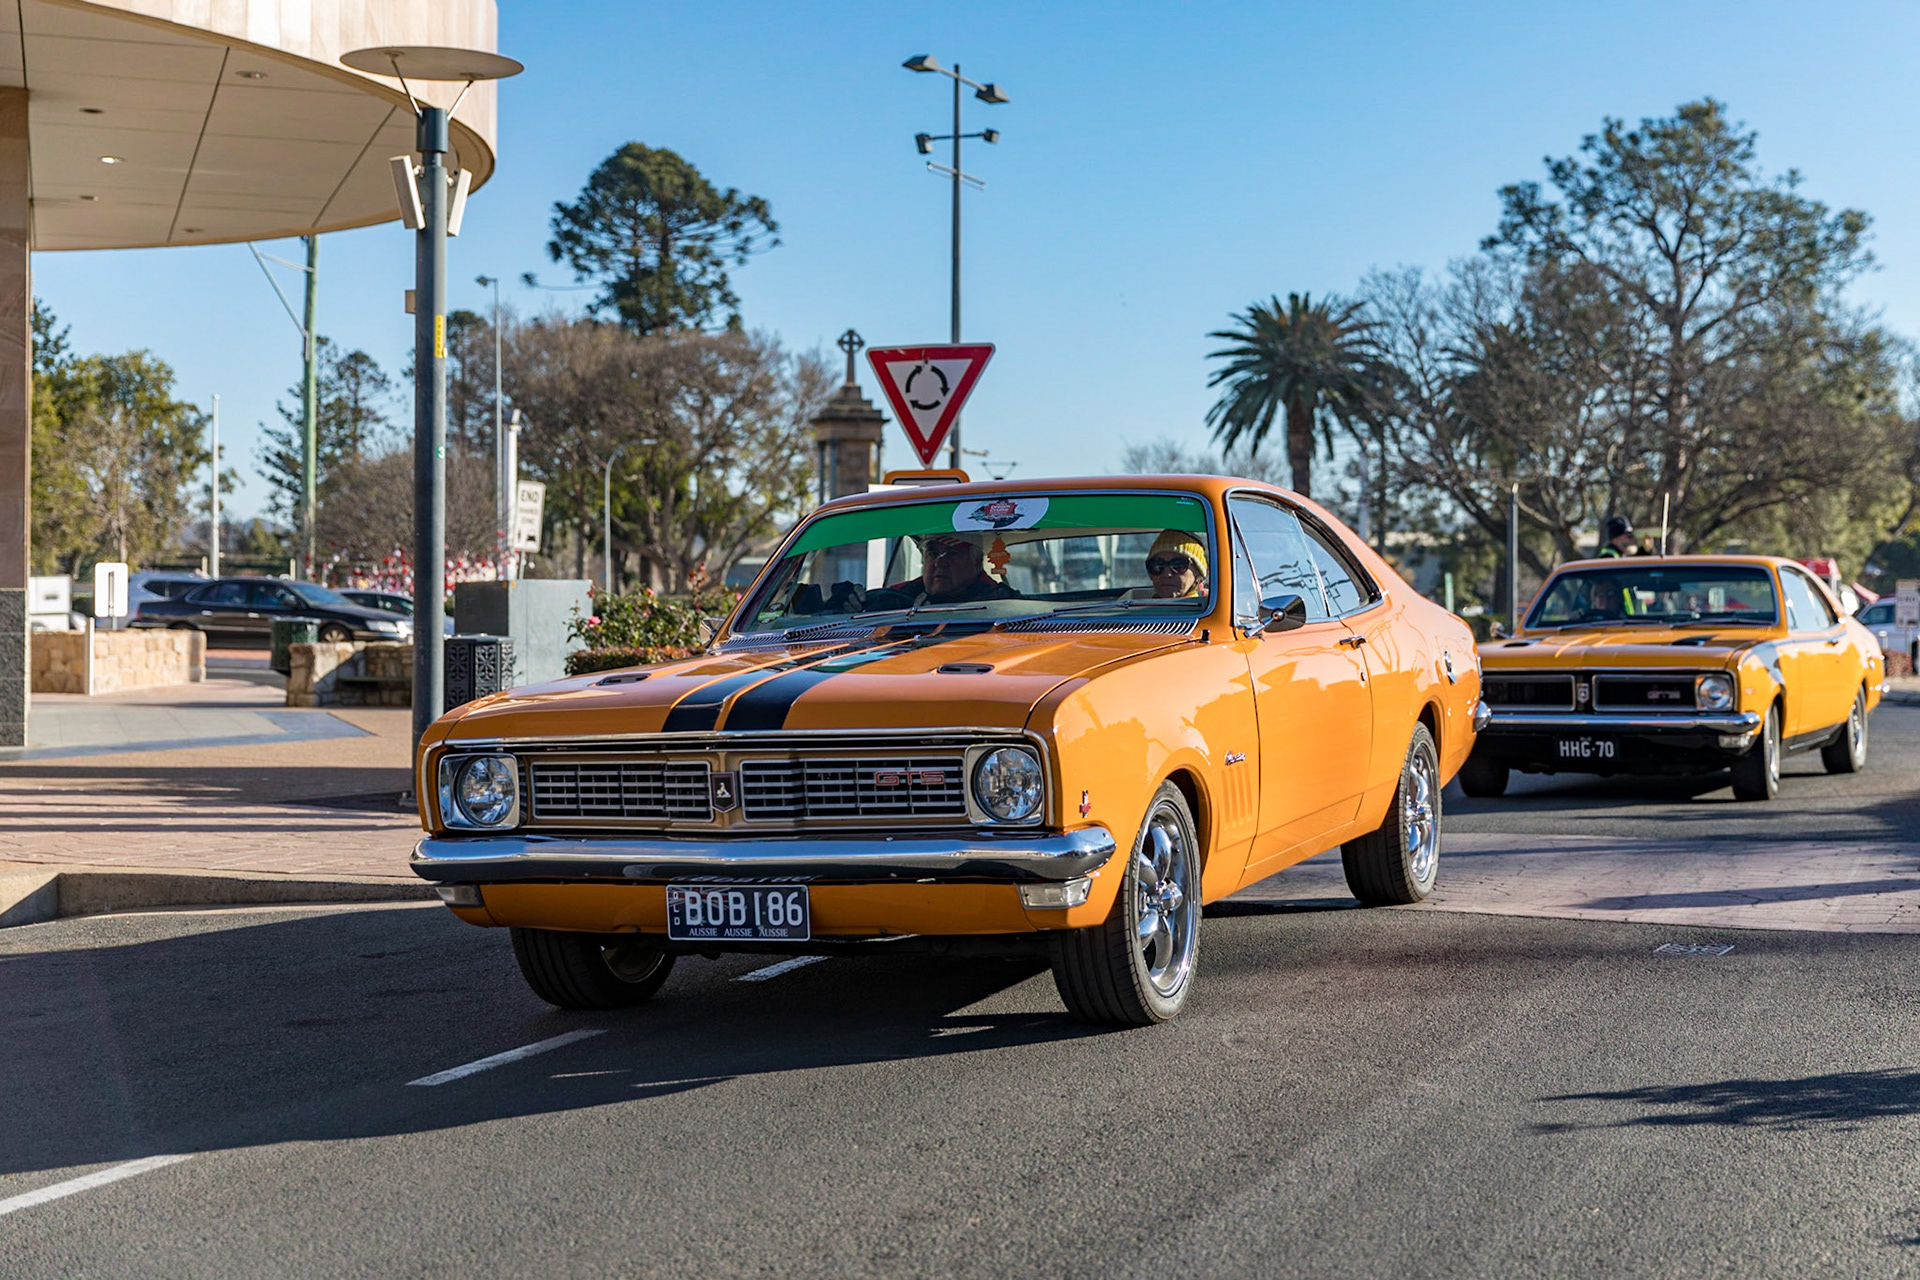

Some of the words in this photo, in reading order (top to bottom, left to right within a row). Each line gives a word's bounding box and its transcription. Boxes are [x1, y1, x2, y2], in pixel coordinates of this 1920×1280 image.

[438, 446, 446, 459] 3
[520, 488, 540, 504] END
[874, 770, 945, 786] GTS
[689, 928, 718, 937] AUSSIE
[724, 928, 753, 937] AUSSIE
[759, 928, 788, 937] AUSSIE
